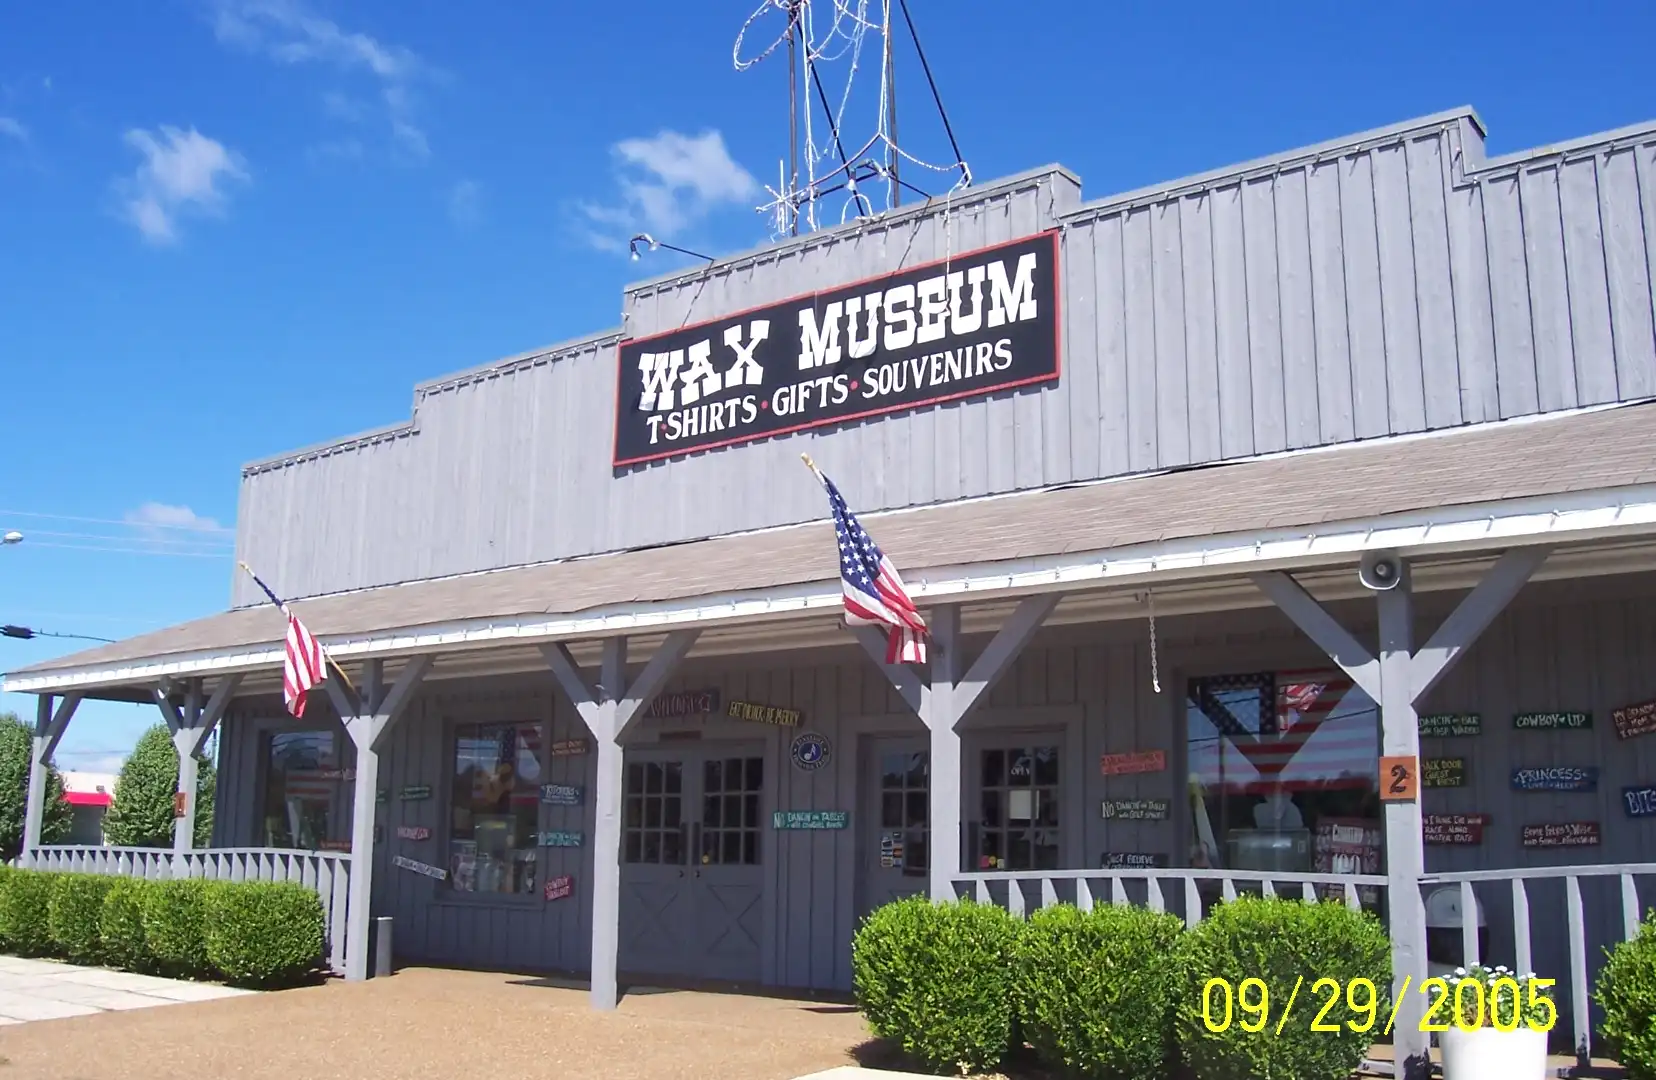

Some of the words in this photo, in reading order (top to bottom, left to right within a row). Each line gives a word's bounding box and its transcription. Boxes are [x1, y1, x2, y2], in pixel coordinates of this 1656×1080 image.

[638, 319, 770, 413] WAX
[798, 252, 1038, 370] MUSEUM
[772, 374, 849, 417] GIFTS
[862, 338, 1014, 399] SOUVENIRS
[1516, 713, 1559, 728] COWBOY
[1566, 713, 1586, 727] UP
[1389, 764, 1408, 794] 2
[1517, 768, 1583, 784] PRINCESS
